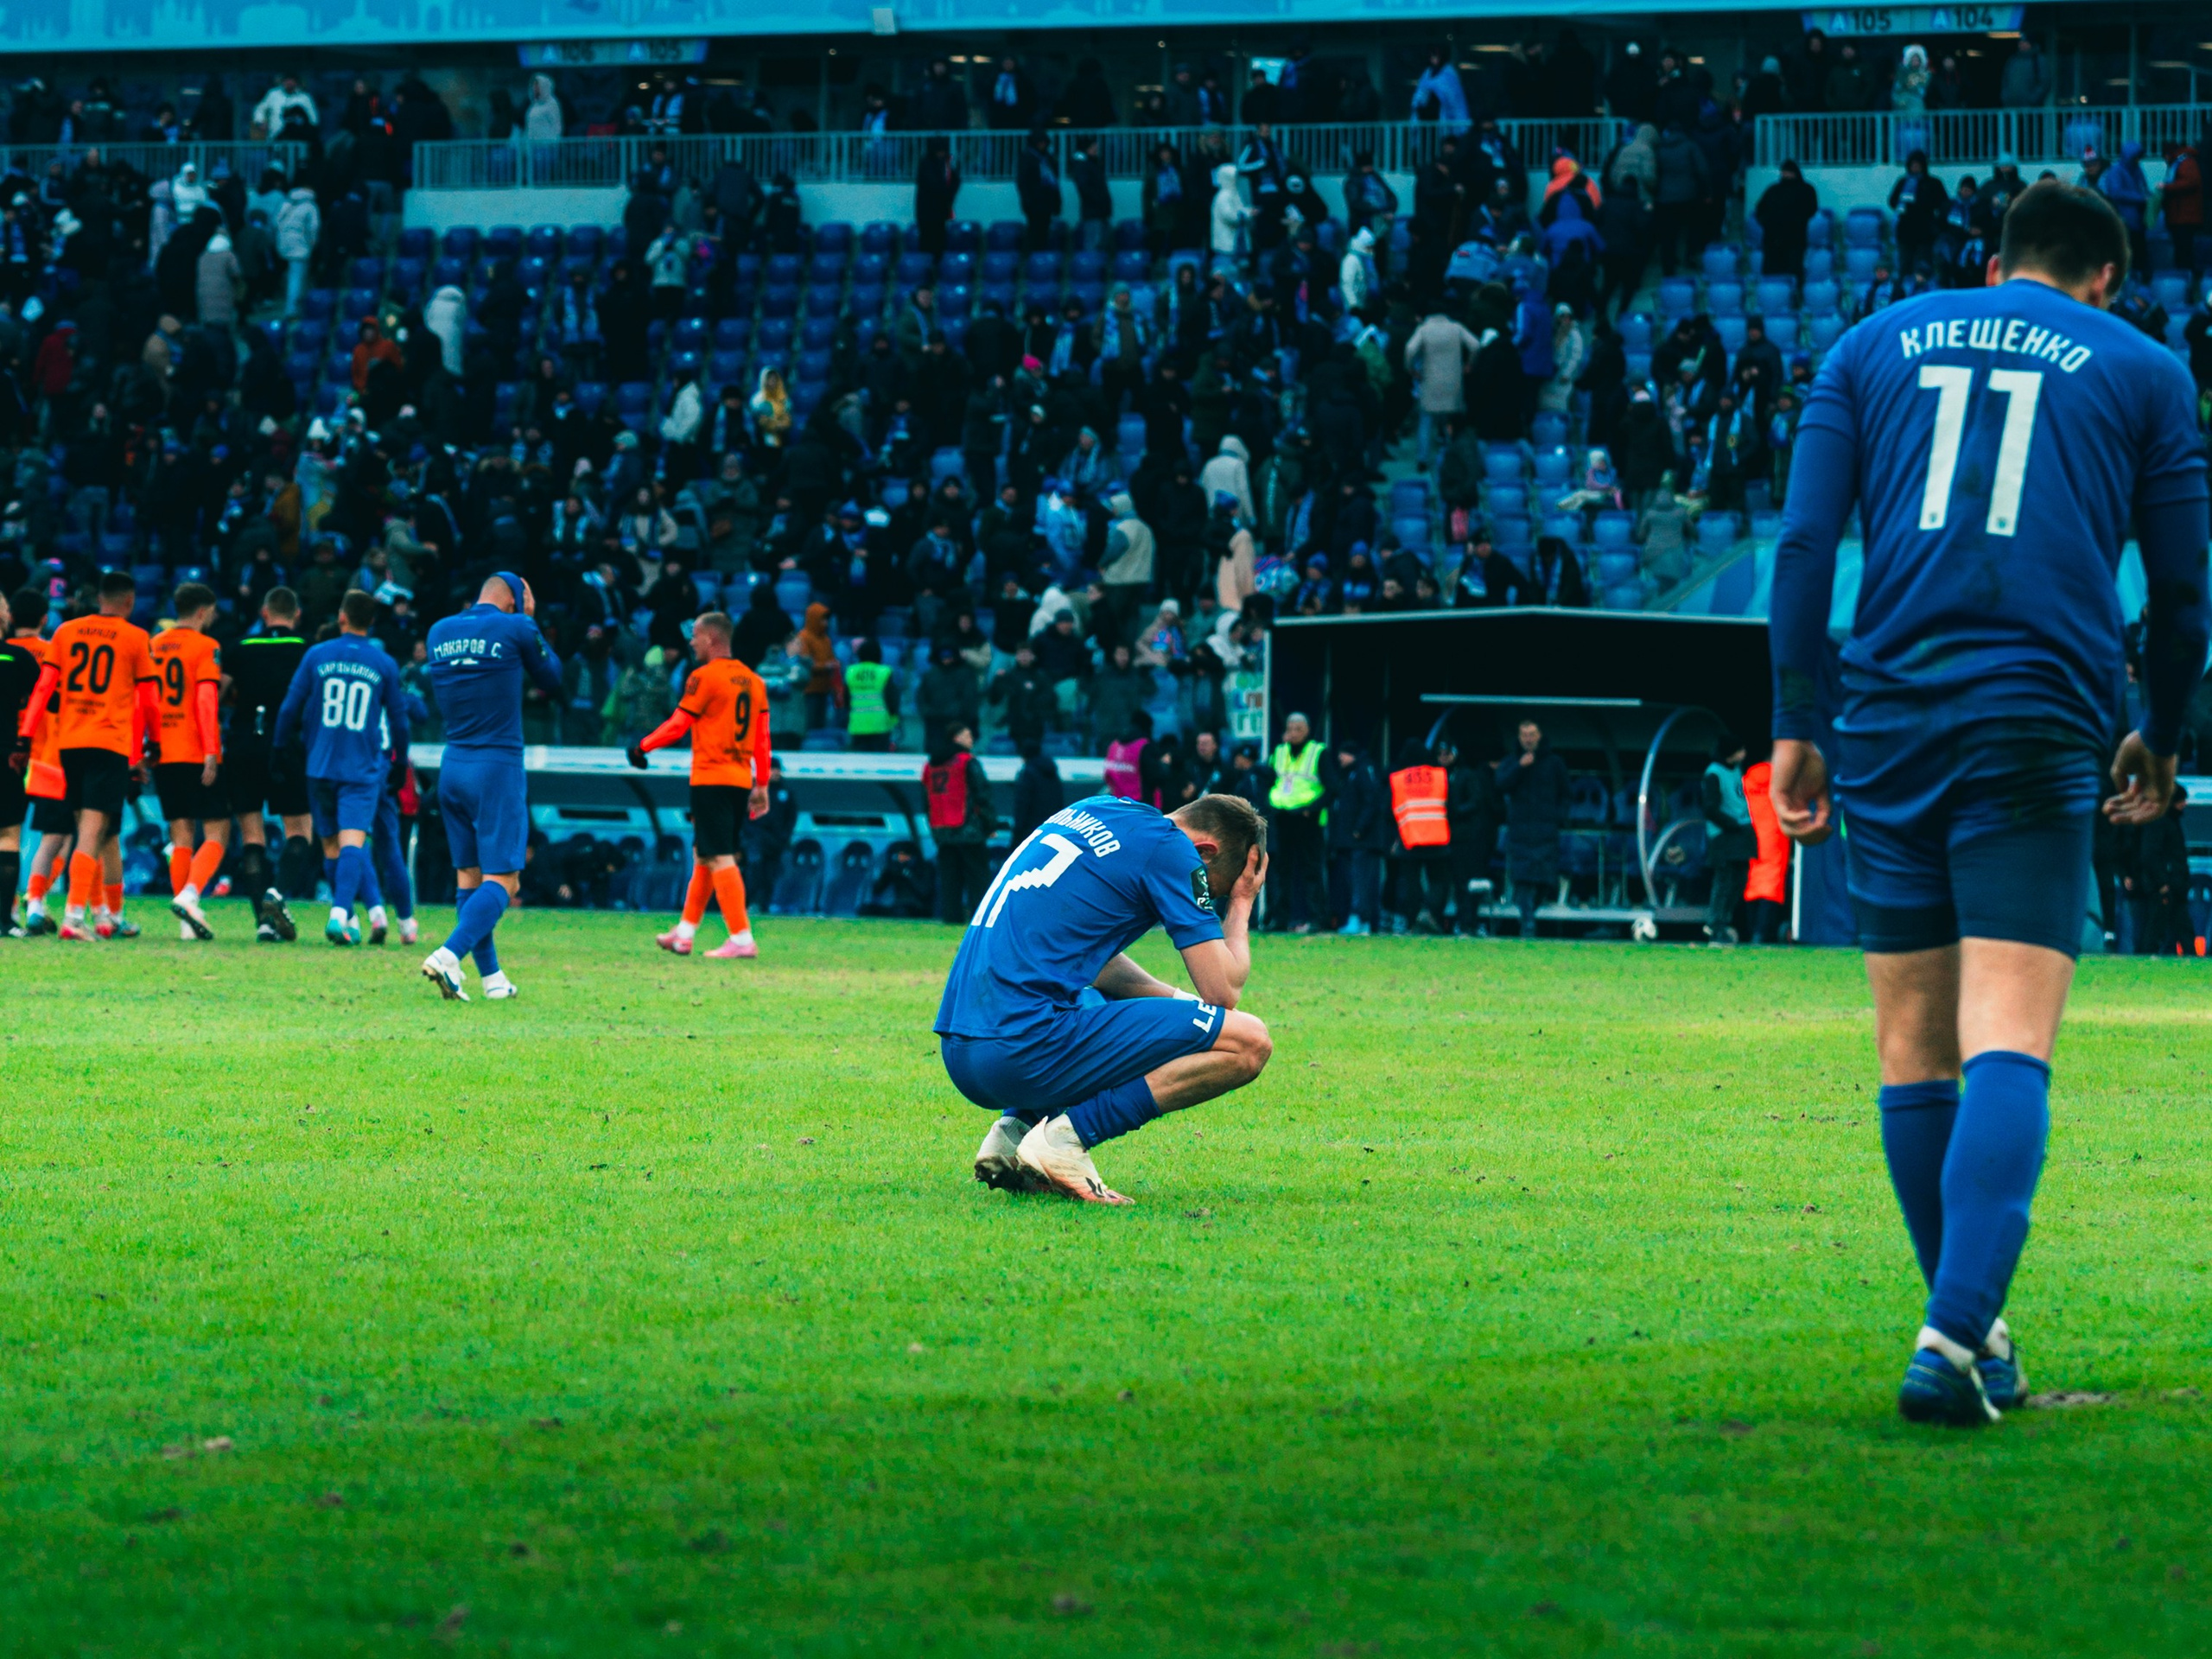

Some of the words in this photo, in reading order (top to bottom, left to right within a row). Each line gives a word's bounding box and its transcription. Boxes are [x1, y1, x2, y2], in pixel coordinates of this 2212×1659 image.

[1853, 11, 1891, 31] 105
[1955, 6, 1993, 28] 104
[1917, 364, 2044, 537] 11
[67, 642, 115, 695] 20
[433, 639, 486, 661] МАКАРОВ
[322, 677, 372, 732] 80
[734, 690, 751, 742] 9
[970, 829, 1084, 928] 17
